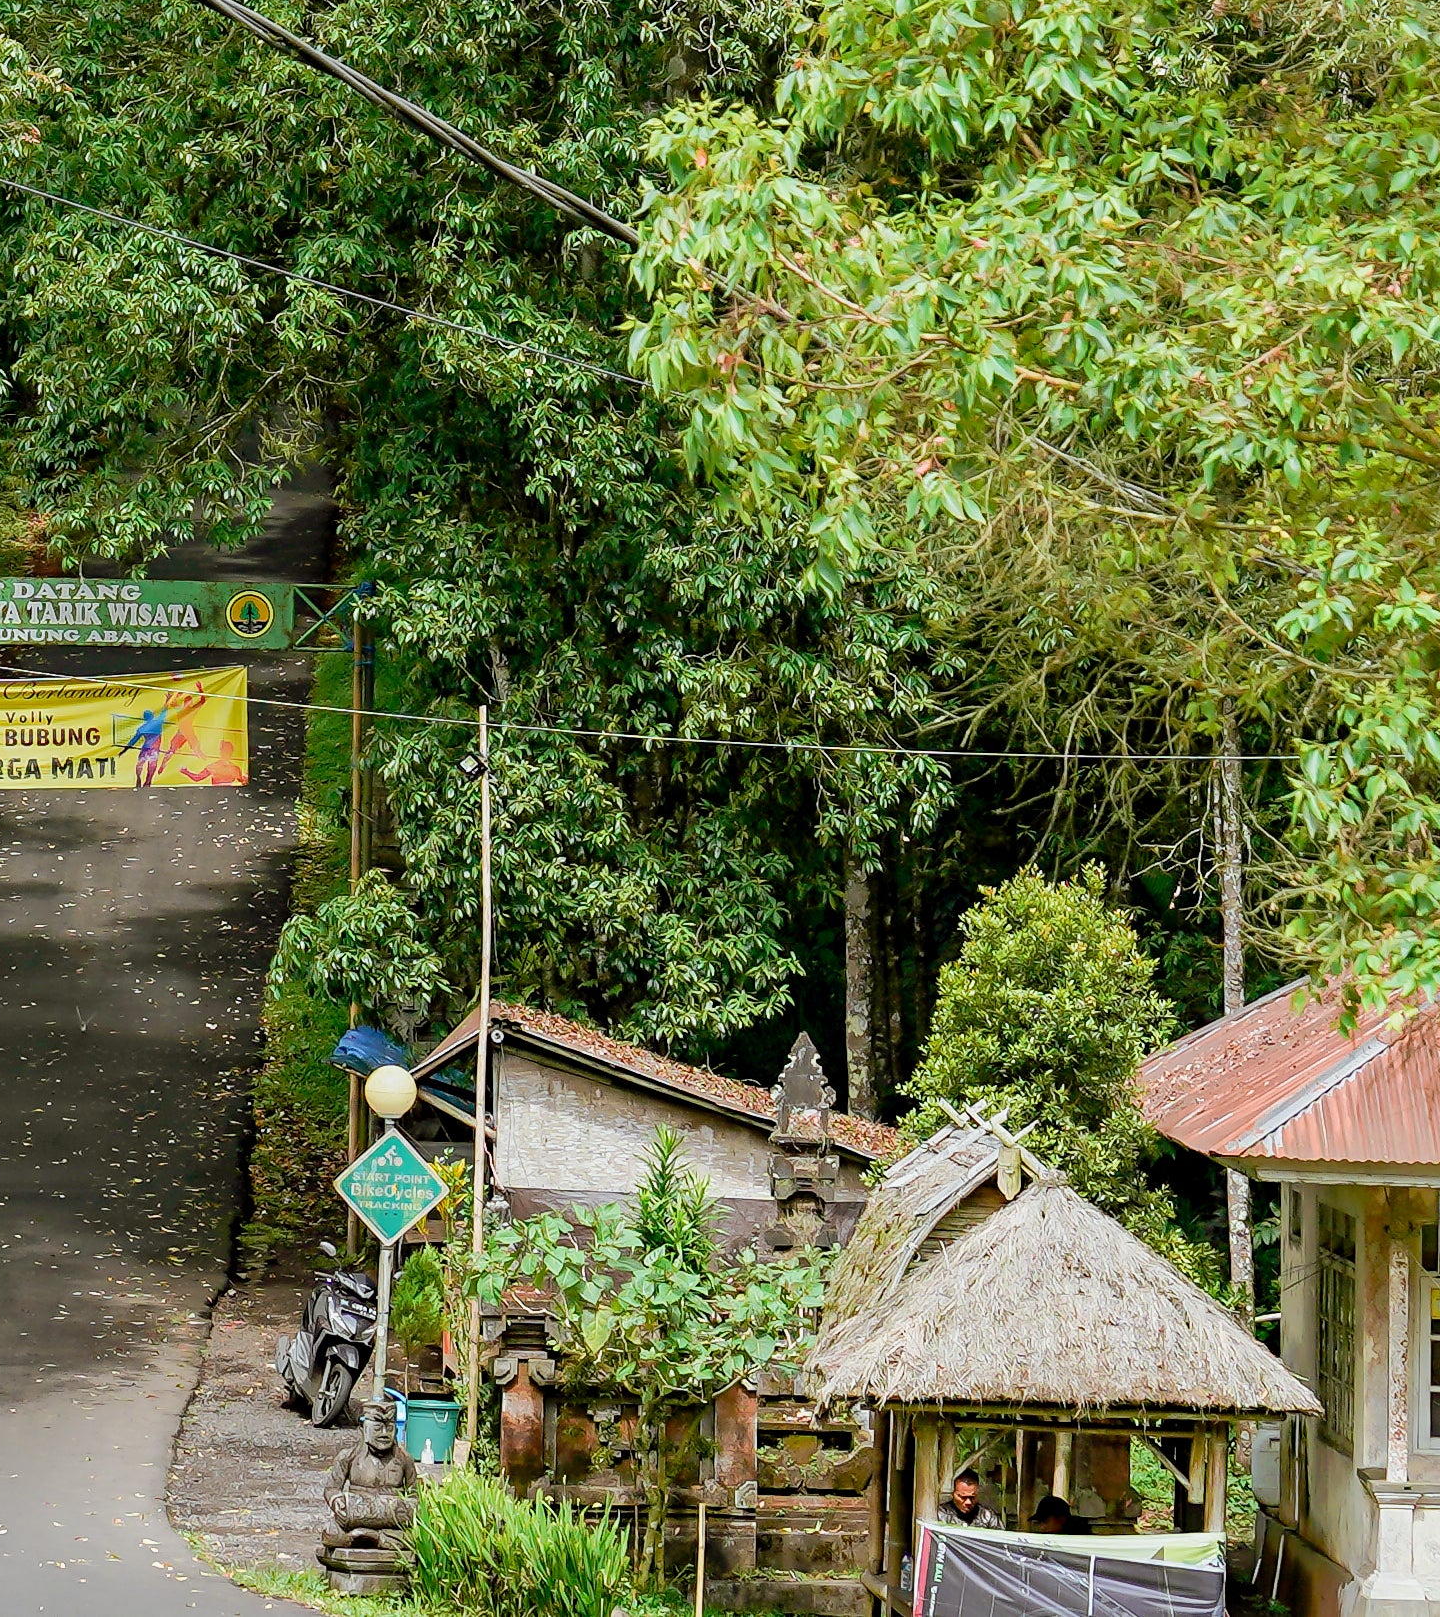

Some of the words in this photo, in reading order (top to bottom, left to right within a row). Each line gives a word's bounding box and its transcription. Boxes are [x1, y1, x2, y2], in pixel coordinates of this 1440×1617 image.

[13, 581, 142, 601] DATANG
[27, 600, 102, 626] TARIK
[108, 602, 199, 628] WISATA
[86, 629, 169, 644] ABANG
[5, 710, 54, 725] Volly
[4, 727, 102, 747] BUBUNG
[52, 756, 117, 780] MATI
[351, 1171, 393, 1183] START
[394, 1174, 431, 1185] POINT
